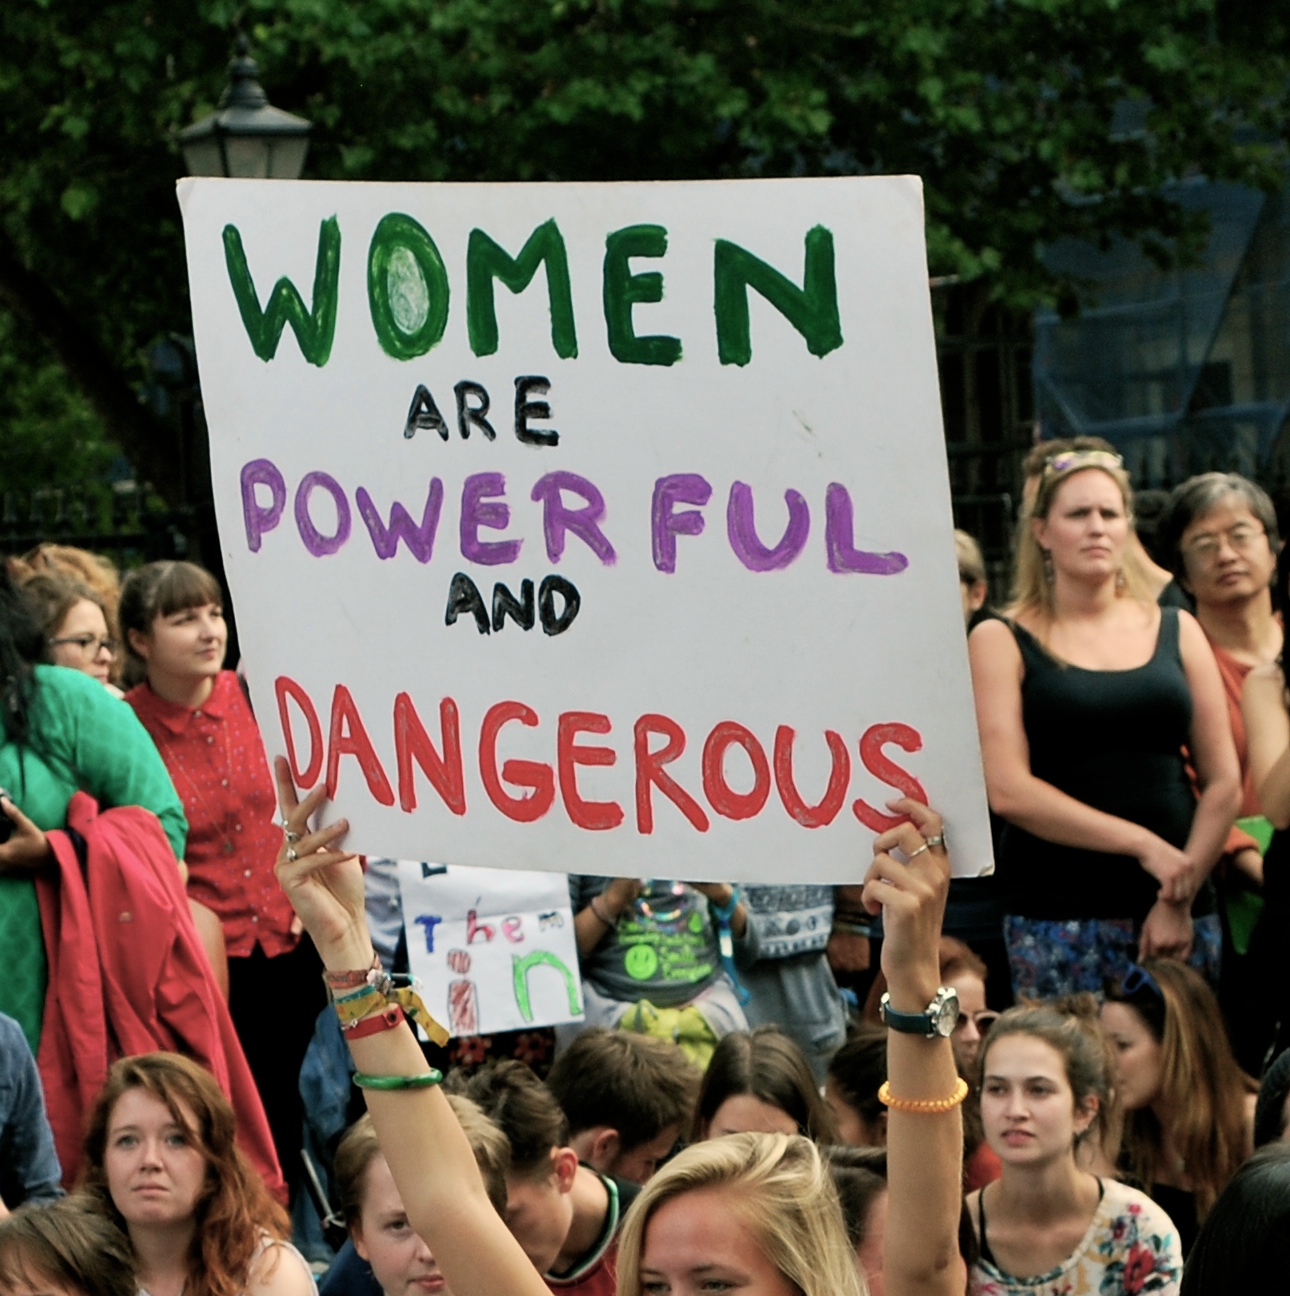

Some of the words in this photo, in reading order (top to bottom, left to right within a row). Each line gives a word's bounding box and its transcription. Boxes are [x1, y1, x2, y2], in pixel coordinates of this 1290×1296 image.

[221, 212, 844, 367] WOMEN
[403, 375, 560, 446] ARE
[239, 458, 909, 575] POWERFUL
[444, 572, 582, 635] AND
[274, 675, 928, 835] DANGEROUS
[447, 949, 584, 1036] in
